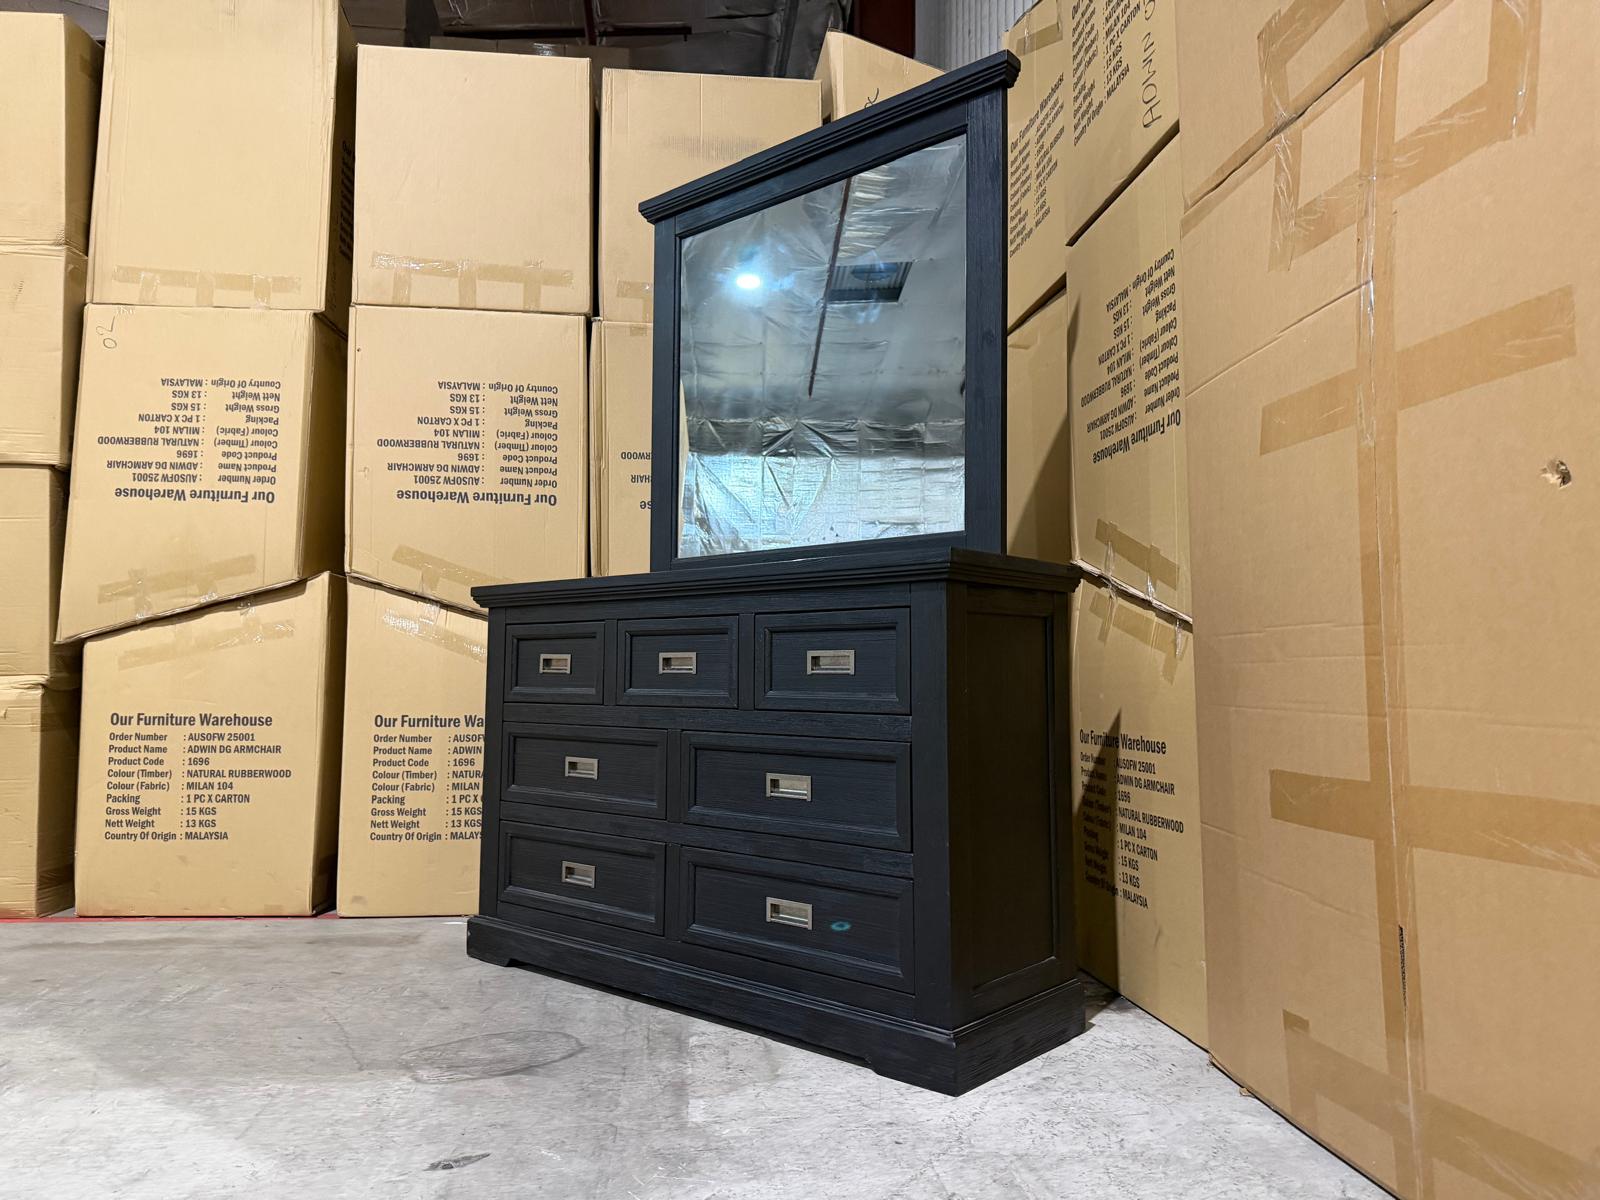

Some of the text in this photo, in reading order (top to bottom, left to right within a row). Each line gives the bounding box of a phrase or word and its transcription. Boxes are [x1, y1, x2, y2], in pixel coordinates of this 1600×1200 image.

[1106, 249, 1174, 312] Country MALAYSIA
[1155, 299, 1176, 324] Packing
[1139, 335, 1178, 368] Colour (Timber)
[1116, 350, 1131, 368] MILAN
[161, 378, 281, 388] Country Origin MALAYSIA
[438, 381, 558, 393] Country Origin MALAYSIA
[232, 391, 280, 400] Nett Weight
[1118, 369, 1179, 413] Product Name ADWIN
[510, 396, 558, 406] Nett Weight
[226, 403, 280, 413] Gross Weight
[504, 408, 558, 417] Gross Weight
[1115, 386, 1180, 432] Order Number AUSOFW
[245, 415, 279, 425] Packing
[417, 417, 558, 429] Packing CARTON
[155, 426, 278, 436] Colour (Fabric) MILAN 104
[434, 429, 558, 440] Colour (Fabric) MILAN 104
[1092, 409, 1181, 464] Our Furniture Warehouse
[98, 436, 278, 448] Colour (Timber) NATURAL RUBBERWOOD
[377, 439, 558, 452] Colour (Timber) NATURAL RUBBERWOOD
[177, 450, 277, 460] Product Code 1696
[458, 453, 557, 463] Product Code 1696
[107, 461, 276, 472] Product Name ADWIN ARMCHAIR
[387, 463, 434, 471] ARMCHAIR
[500, 466, 523, 475] Name
[525, 467, 557, 475] Product
[132, 473, 276, 484] Order Number AUSOFW 25001
[414, 475, 557, 488] Order Number AUSOFW 25001
[115, 488, 275, 503] Our Furniture Warehouse
[396, 490, 557, 506] Our Furniture Warehouse
[110, 713, 272, 726] Our Furniture Warehouse
[375, 715, 397, 727] Our
[401, 715, 460, 727] Furniture
[109, 733, 255, 741] Order Number AUSOFW 25001
[374, 734, 484, 743] Order Number AUSOF
[1080, 729, 1166, 754] Our Warehouse
[109, 745, 141, 753] Product
[144, 745, 167, 753] Name
[234, 745, 281, 753] ARMCHAIR
[374, 747, 406, 755] Product
[408, 747, 432, 755] Name
[108, 757, 141, 765] Product
[373, 759, 405, 767] Product
[408, 759, 429, 767] Code
[1138, 761, 1156, 774] 25001
[137, 770, 172, 779] (Timber)
[372, 771, 399, 779] Colour
[402, 771, 437, 781] (Timber)
[107, 782, 233, 791] Colour (Fabric) MILAN 104
[372, 783, 399, 791] Colour
[402, 783, 435, 793] (Fabric)
[1144, 779, 1174, 795] ARMCHAIR
[106, 794, 250, 804] Packing CARTON
[372, 795, 405, 805] Packing
[1118, 791, 1130, 803] 1696
[131, 807, 161, 817] Weight
[397, 808, 426, 817] Weight
[125, 819, 155, 829] Weight
[1119, 807, 1184, 833] NATURAL RUBBERWOOD
[391, 821, 420, 830] Weight
[105, 832, 228, 841] Country Origin MALAYSIA
[370, 831, 482, 842] Country Origin MALAY
[1137, 846, 1158, 861] CARTON
[1123, 889, 1148, 908] MALAYSIA
